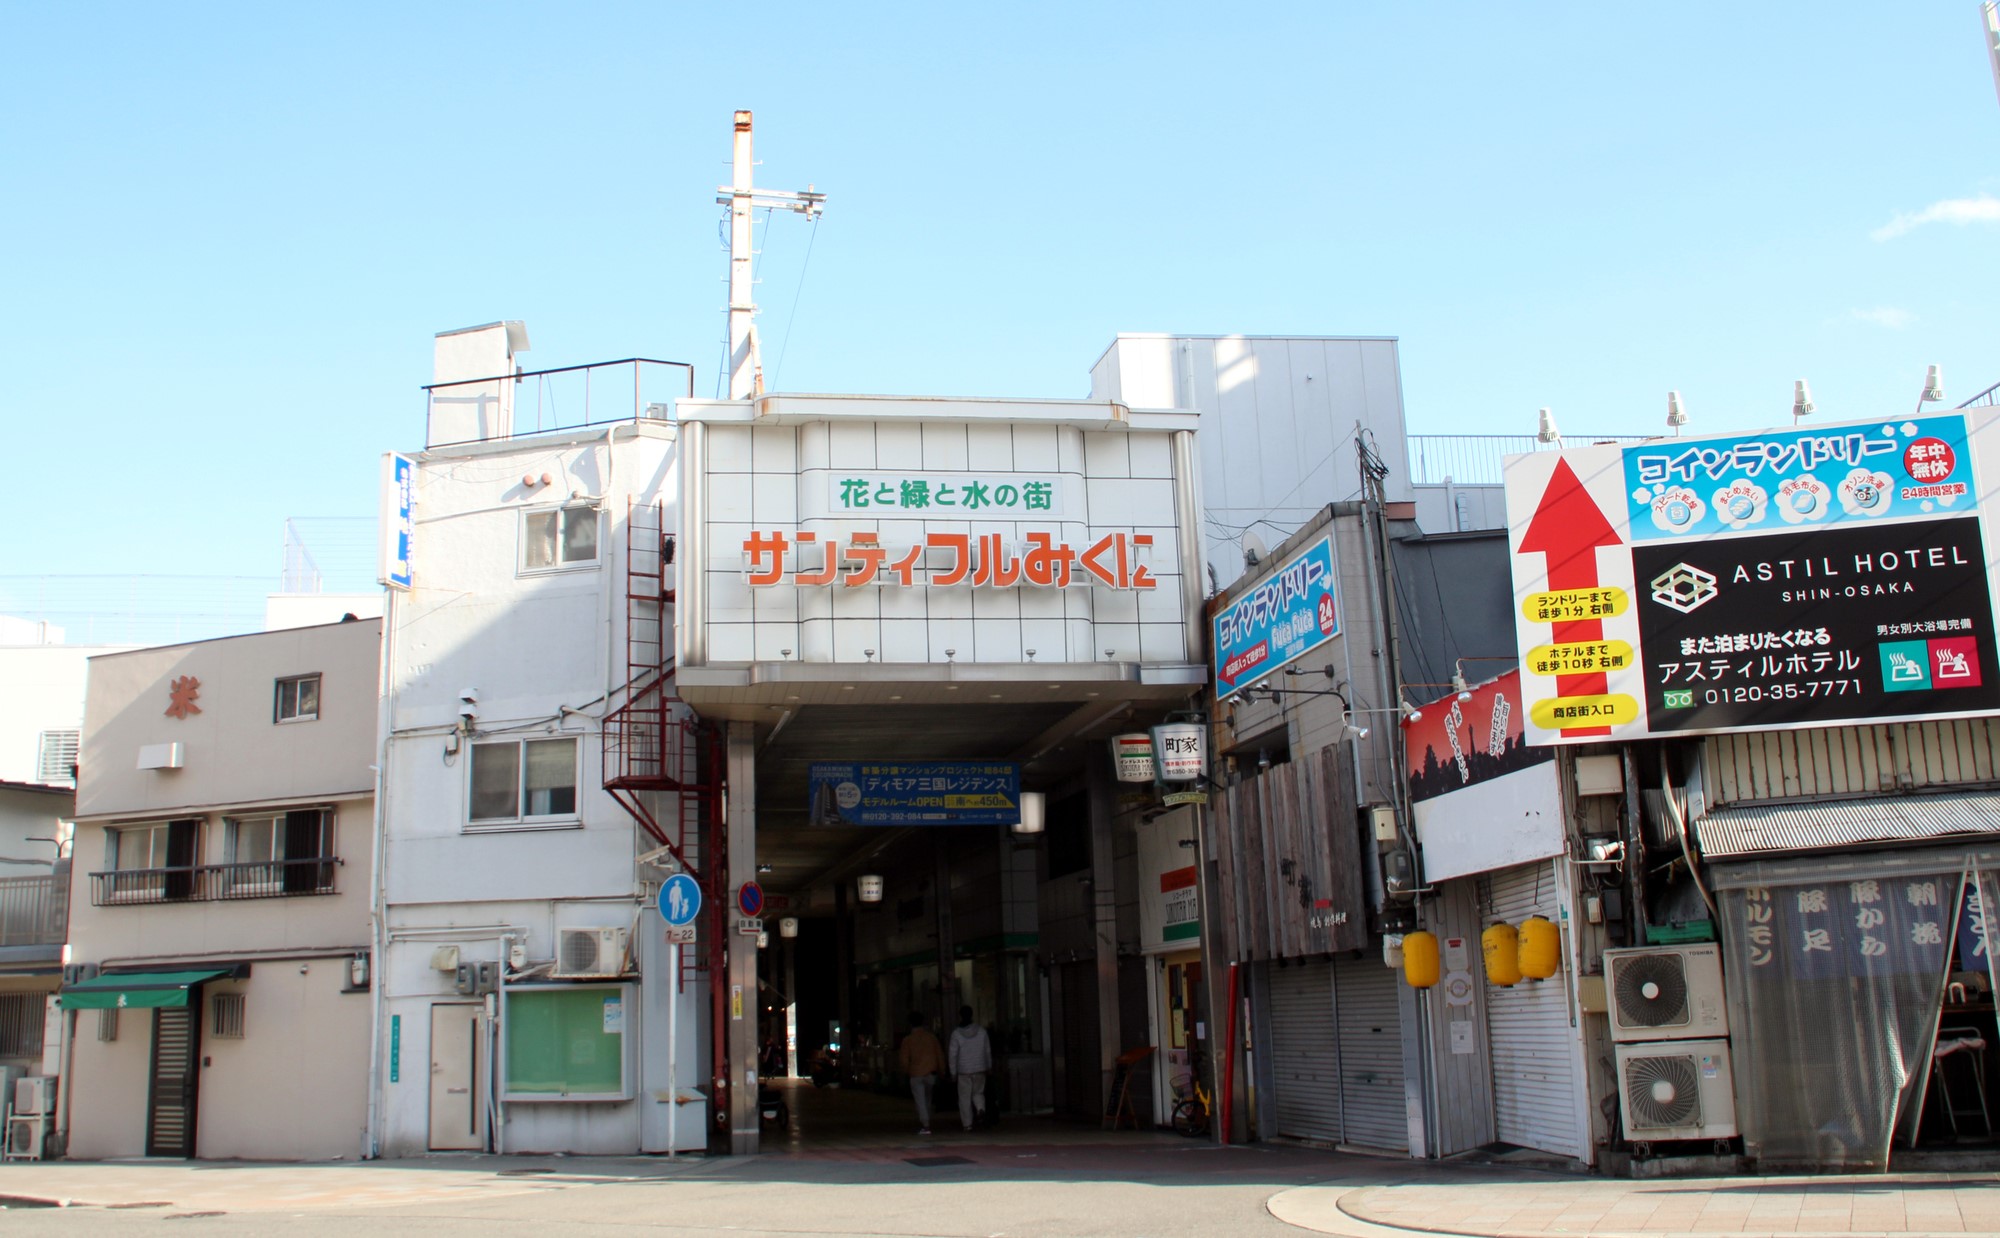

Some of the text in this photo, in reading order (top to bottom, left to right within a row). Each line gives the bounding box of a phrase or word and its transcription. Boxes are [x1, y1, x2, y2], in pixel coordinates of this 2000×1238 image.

[1638, 434, 1897, 484] コインランドリー
[1910, 443, 1946, 460] 年中
[1911, 460, 1949, 479] 無休
[840, 478, 1053, 512] 花と緑と水の街
[1719, 486, 1760, 505] まとめ洗い
[1782, 480, 1820, 497] 羽毛布団
[1901, 483, 1966, 500] 24時間営業
[742, 530, 1158, 591] サンティフルみくに
[1733, 546, 1968, 583] ASTIL HOTEL
[1538, 591, 1612, 606] ランドリーまで
[1782, 581, 1914, 602] SHIN-OSAKA
[1219, 557, 1324, 651] コインランドリー
[1319, 598, 1333, 625] 24
[1538, 603, 1614, 619] 徒歩1分 右側
[1877, 618, 1972, 636] 男女別大浴場完備
[1680, 627, 1831, 656] また泊まりたくなる
[1549, 645, 1608, 659] ホテルまで
[1537, 656, 1623, 672] 徒歩10秒 右側
[1658, 649, 1860, 684] アスティルホテル
[1704, 679, 1862, 704] 0120-35-7771
[1553, 704, 1615, 718] 商店街入口
[1164, 736, 1198, 753] 町家
[1746, 887, 1773, 966] ホルモン
[1797, 889, 1832, 953] 豚足
